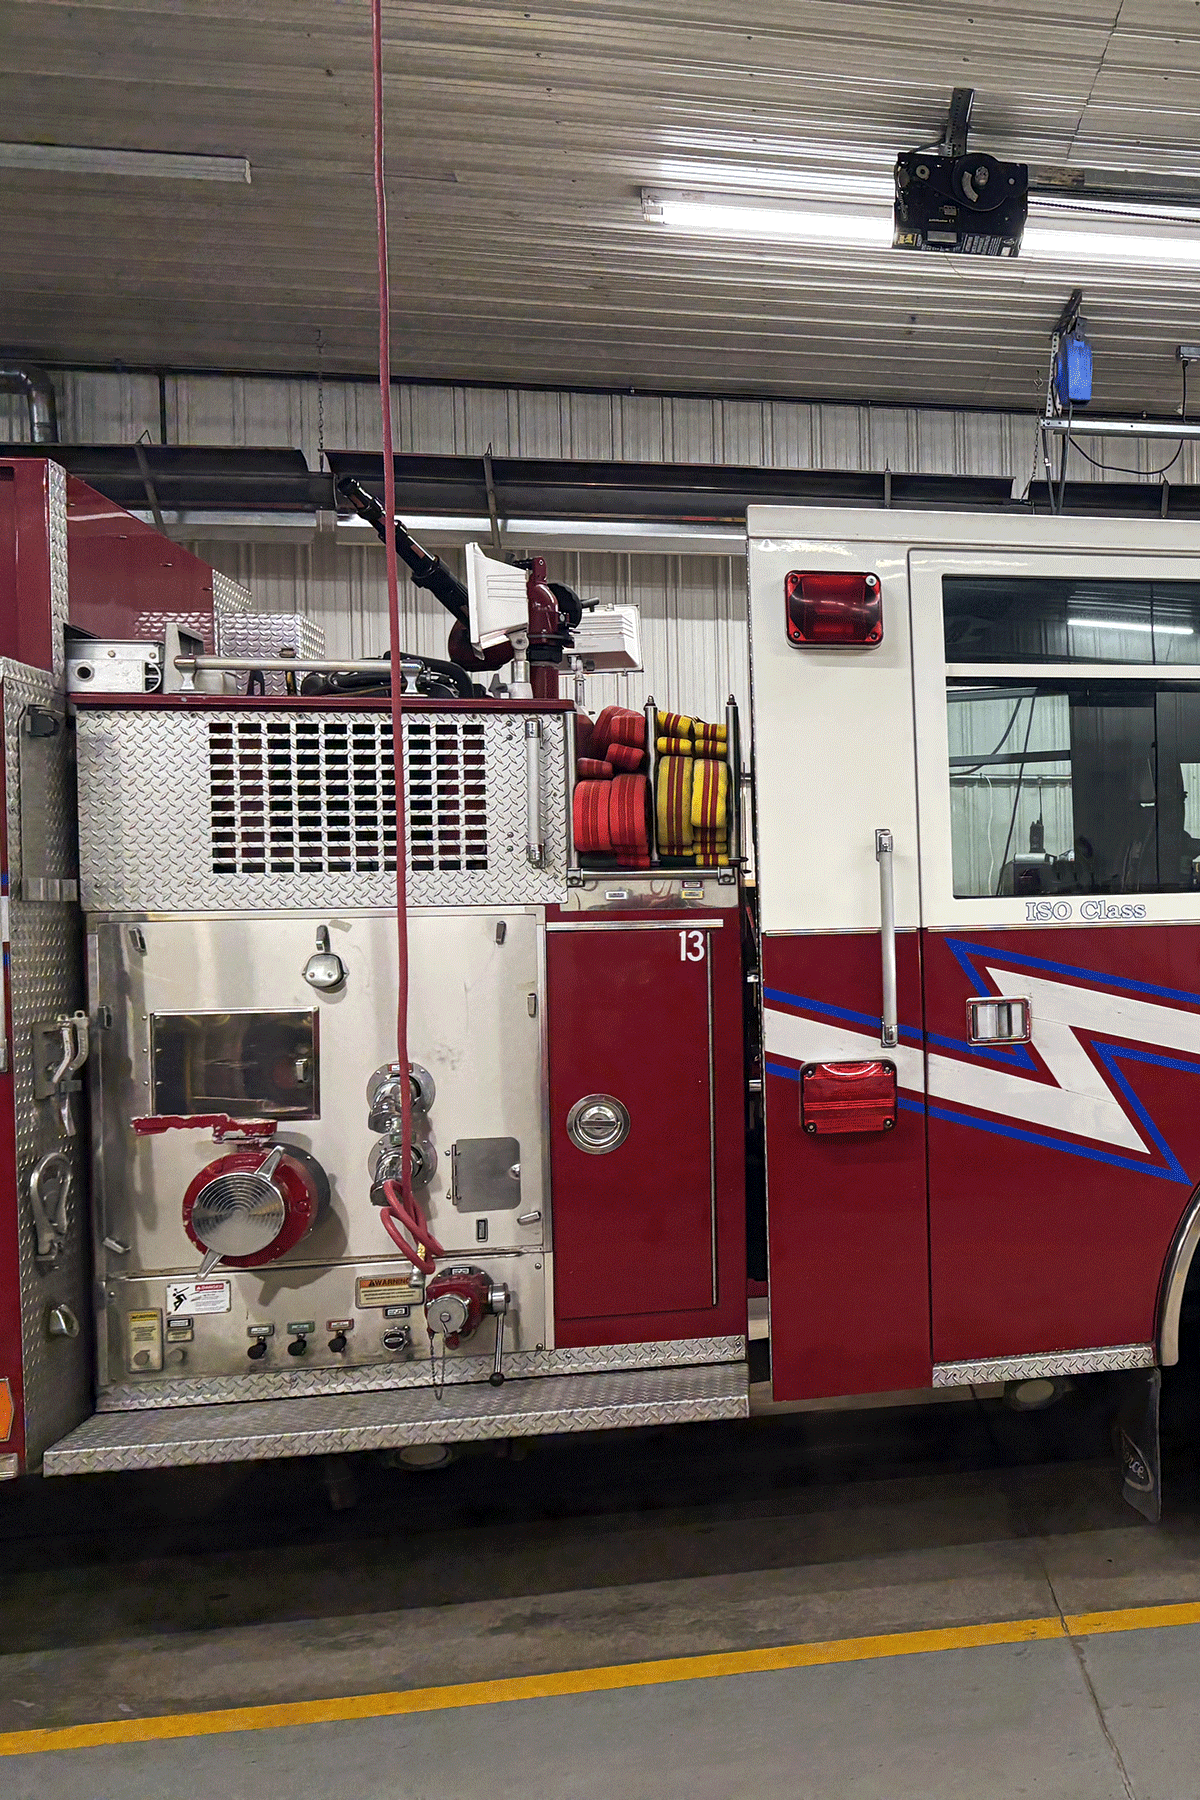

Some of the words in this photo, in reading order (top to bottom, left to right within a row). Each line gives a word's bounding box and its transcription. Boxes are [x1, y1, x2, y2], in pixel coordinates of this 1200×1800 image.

[1025, 901, 1073, 921] ISO
[1080, 900, 1147, 920] Class
[678, 930, 705, 962] 13
